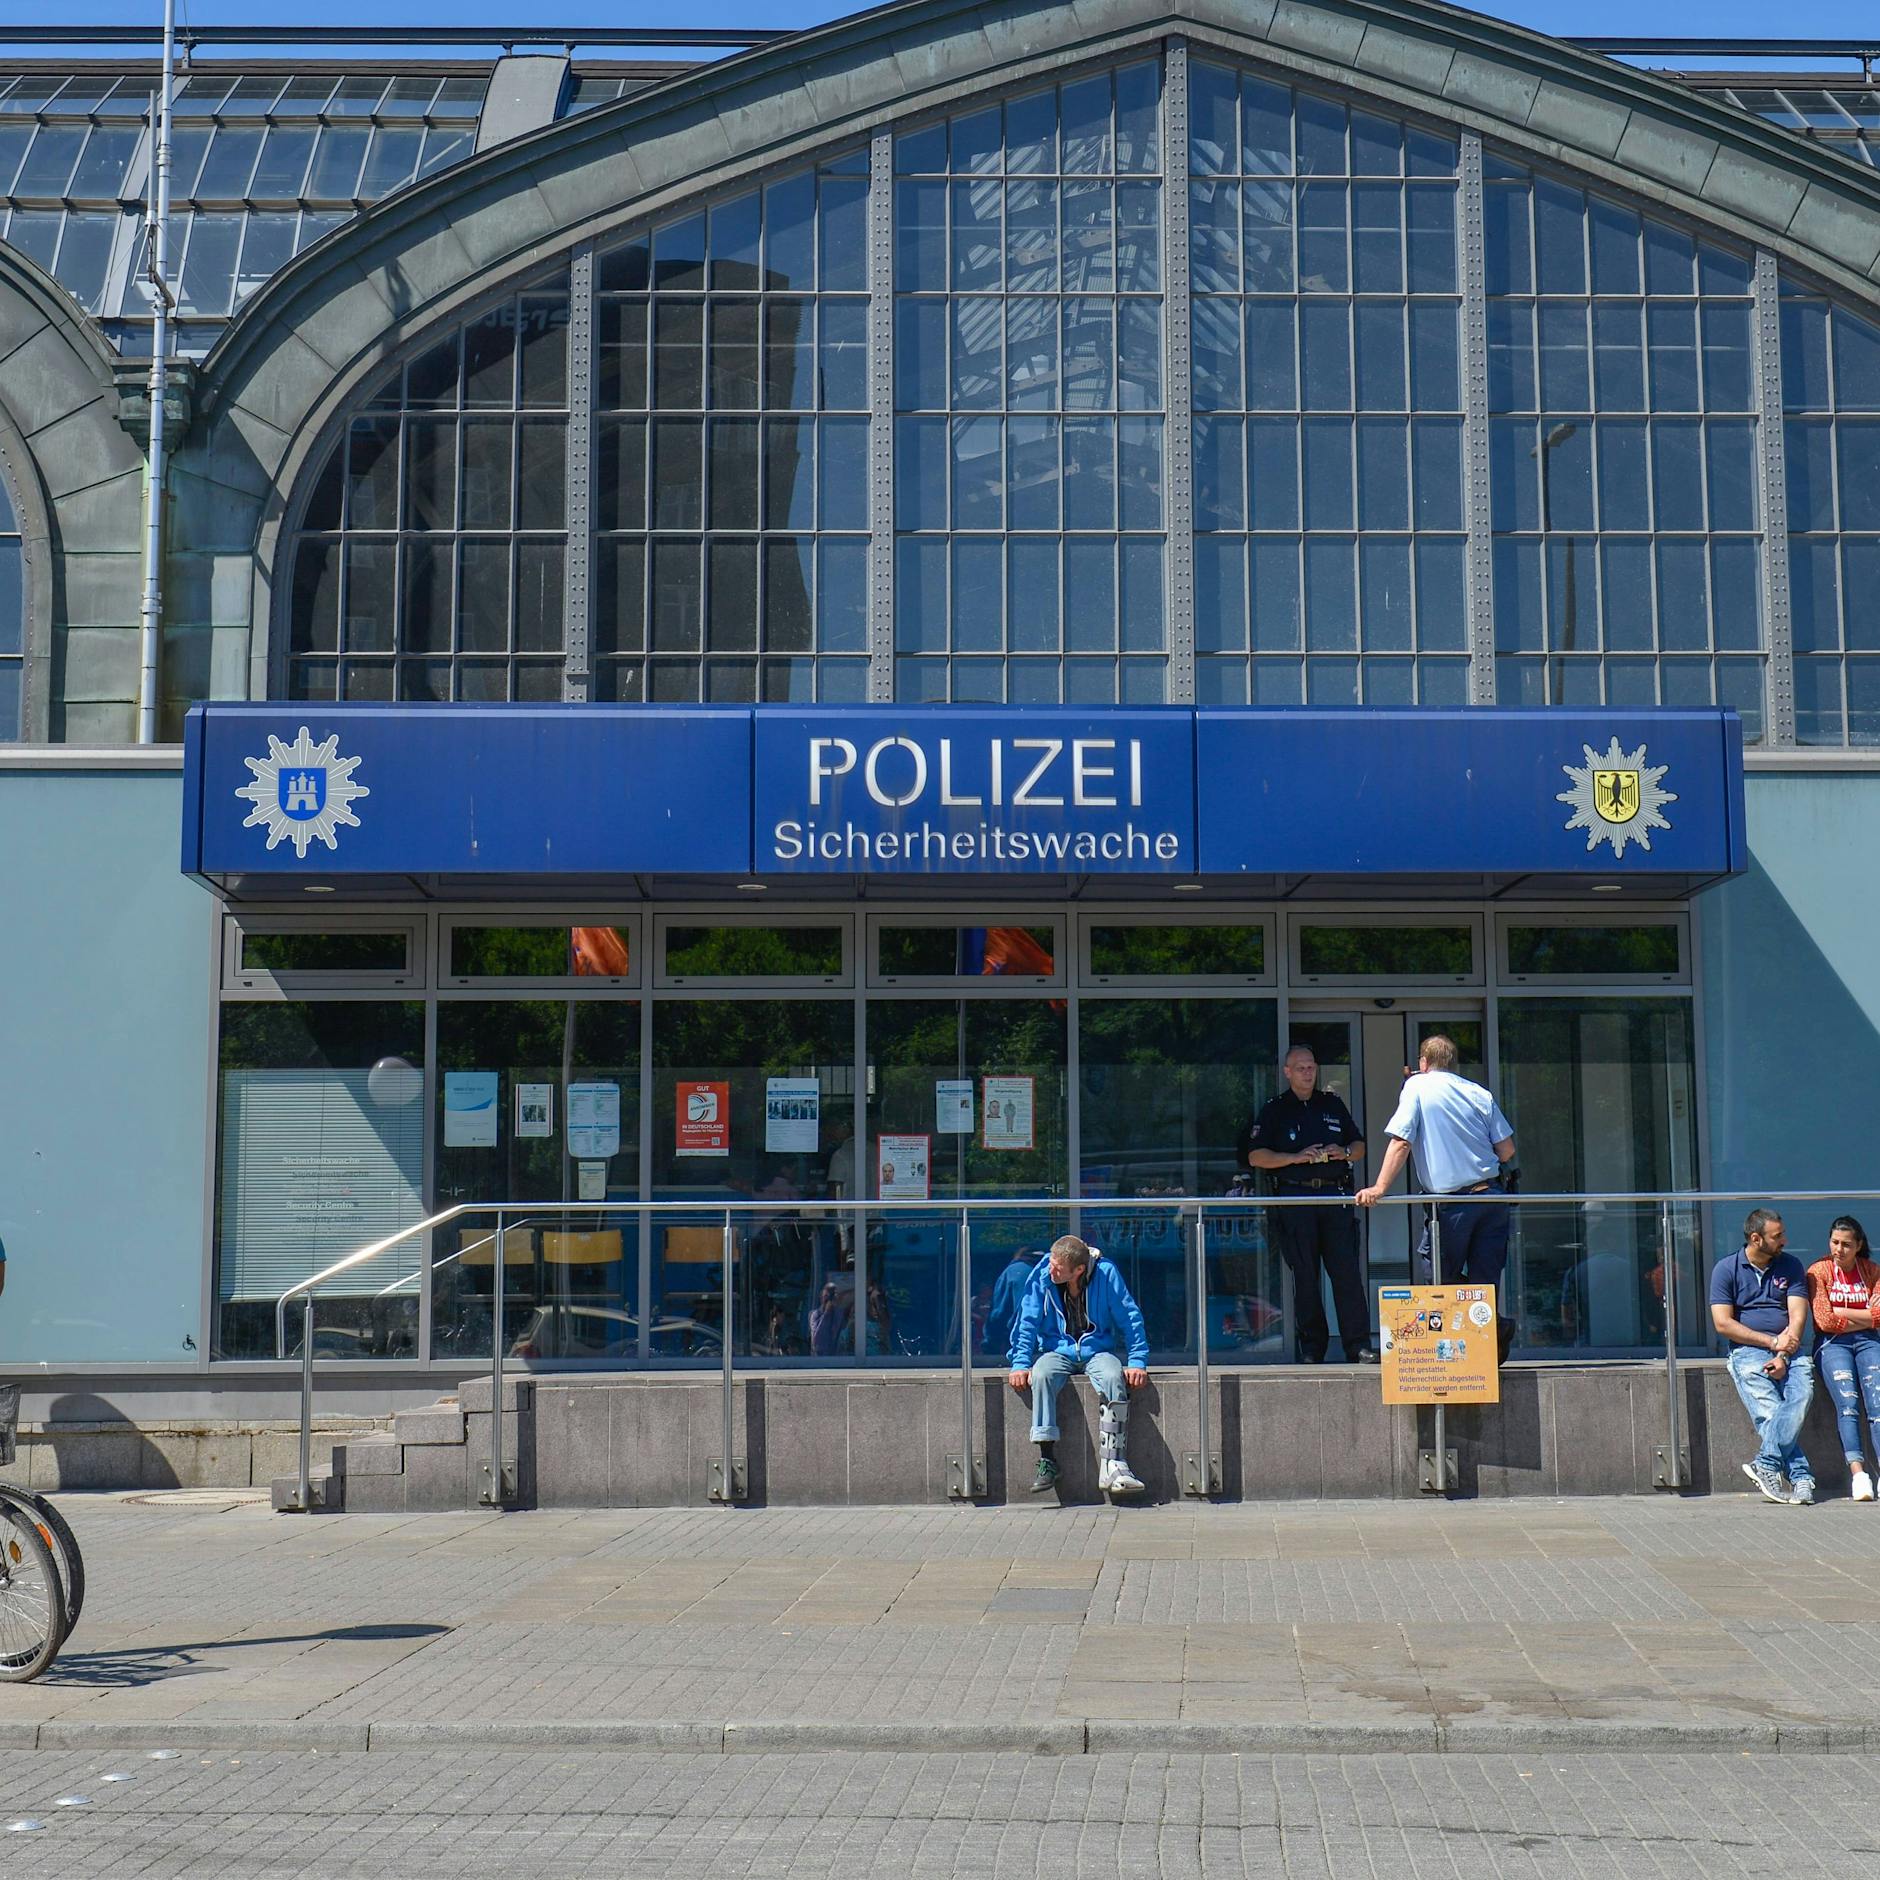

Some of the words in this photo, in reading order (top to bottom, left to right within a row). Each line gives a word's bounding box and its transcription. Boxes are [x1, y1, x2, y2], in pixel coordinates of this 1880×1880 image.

[809, 736, 1142, 807] POLIZEI
[773, 821, 1180, 860] Sicherheitswache
[1398, 1347, 1411, 1355] Das
[1399, 1375, 1447, 1383] Widerrechtlich
[1448, 1375, 1486, 1383] abgestellte
